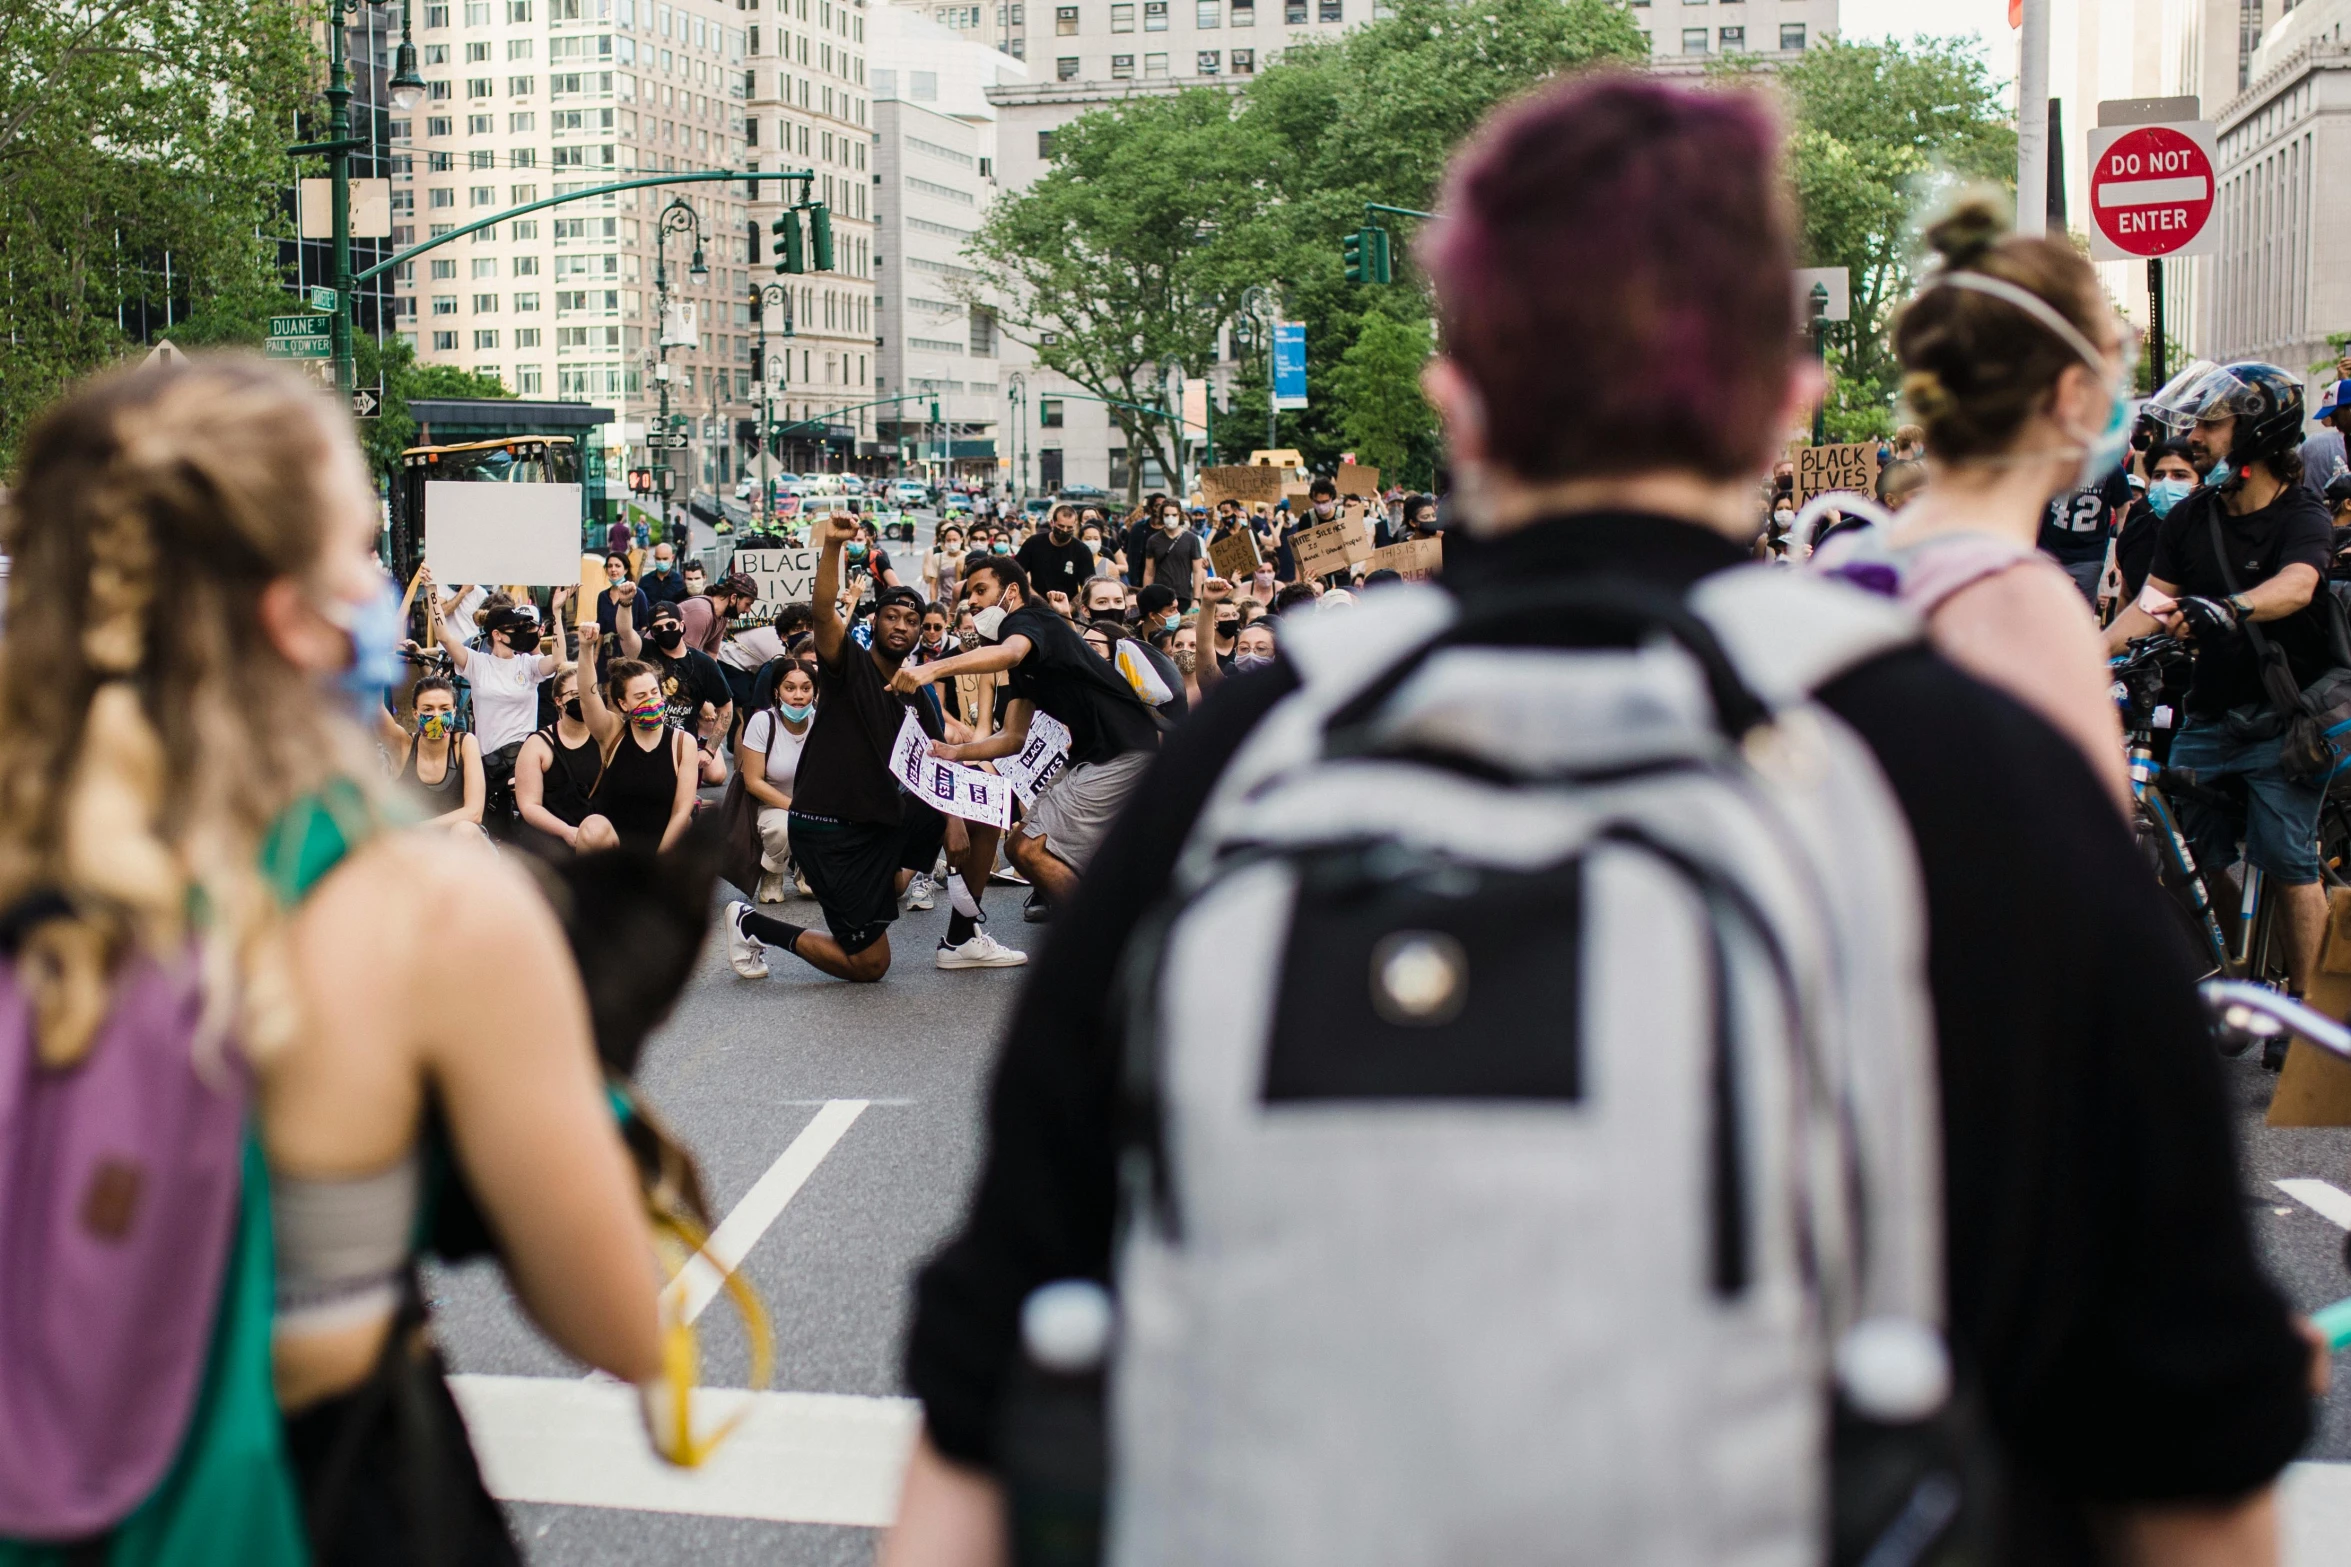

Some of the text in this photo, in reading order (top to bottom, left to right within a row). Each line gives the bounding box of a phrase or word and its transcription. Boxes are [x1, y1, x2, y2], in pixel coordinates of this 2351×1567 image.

[2111, 149, 2192, 176] DO NOT
[2119, 208, 2188, 234] ENTER
[273, 318, 326, 336] DUANE ST
[266, 339, 330, 352] PAUL O'DWYER
[1801, 447, 1867, 472] BLACK
[1800, 466, 1868, 491] LIVES
[2051, 494, 2102, 533] 42
[1315, 522, 1347, 539] SILENCE
[1215, 535, 1244, 556] BLACK
[1220, 546, 1249, 568] LIVES
[1307, 541, 1318, 551] IS
[1381, 542, 1430, 559] THIS IS A
[430, 592, 443, 626] BLM
[1021, 738, 1045, 769] BLACK
[938, 768, 951, 797] LIVES
[1034, 757, 1064, 791] LIVES
[972, 785, 984, 804] BLACK
[801, 813, 839, 823] HILFIGER
